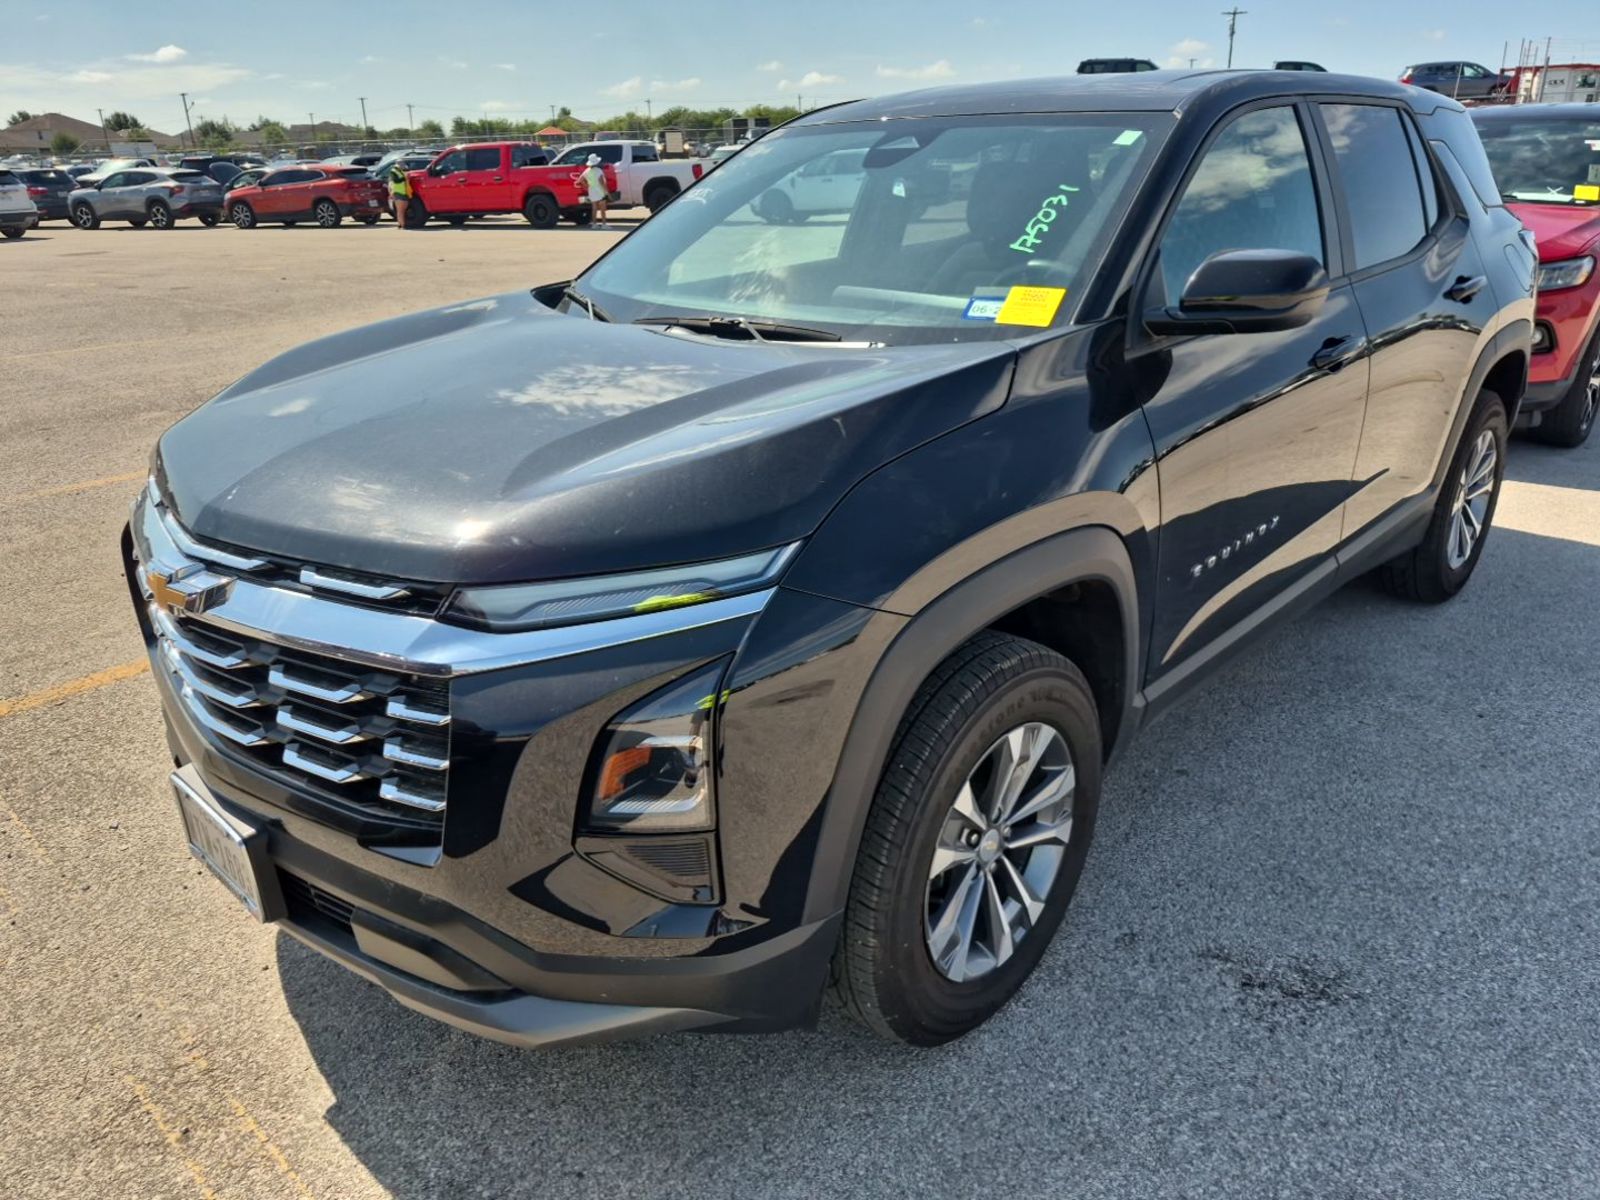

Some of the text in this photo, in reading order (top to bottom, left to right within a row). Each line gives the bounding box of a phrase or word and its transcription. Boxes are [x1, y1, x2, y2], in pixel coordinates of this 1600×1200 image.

[1009, 184, 1080, 254] 175031
[971, 304, 1002, 315] 06-2
[1192, 515, 1280, 577] EQUINOX
